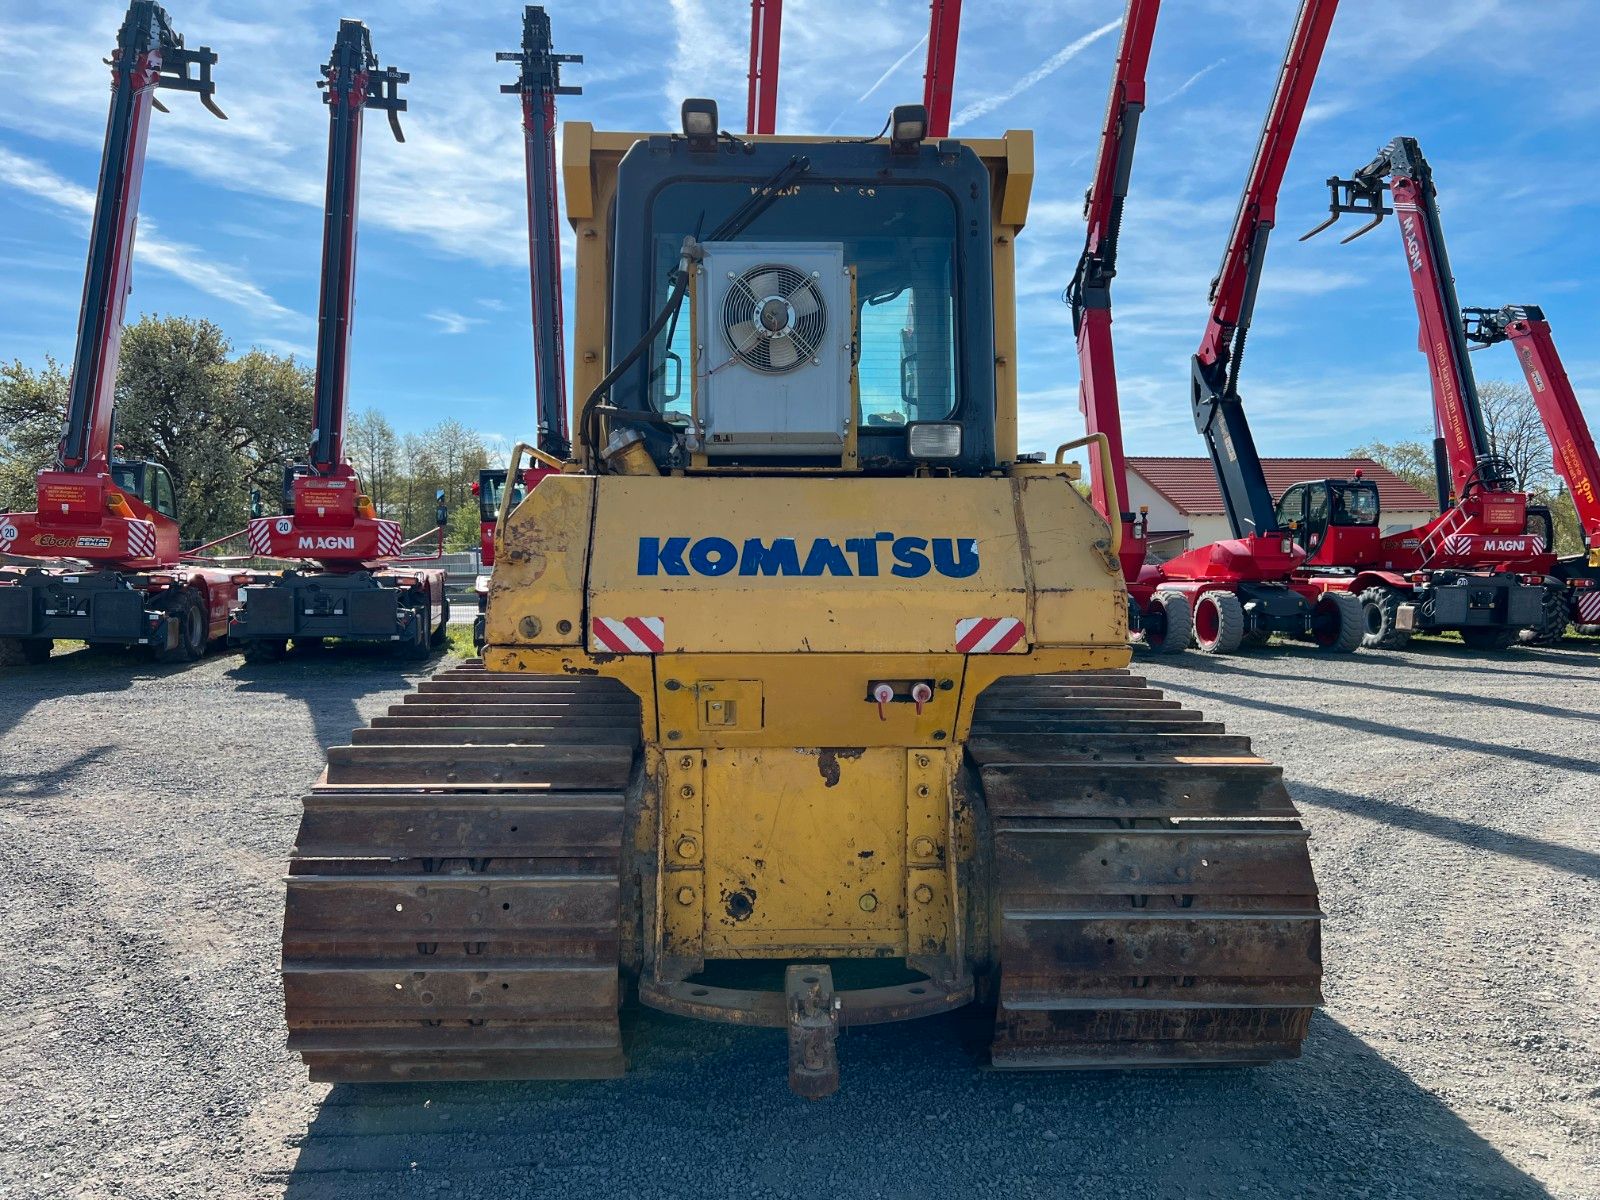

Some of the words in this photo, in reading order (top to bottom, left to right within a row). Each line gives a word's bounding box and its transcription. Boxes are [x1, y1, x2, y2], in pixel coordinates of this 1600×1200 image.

[1403, 216, 1422, 272] MAGNI
[1436, 342, 1446, 366] mich
[1441, 366, 1452, 391] kann
[1447, 392, 1457, 414] man
[1452, 415, 1467, 451] mieten!
[4, 528, 15, 538] 20
[279, 521, 289, 532] 20
[39, 533, 76, 548] Ebert
[298, 536, 355, 549] MAGNI
[1483, 540, 1526, 551] MAGNI
[636, 531, 981, 579] KOMATSU
